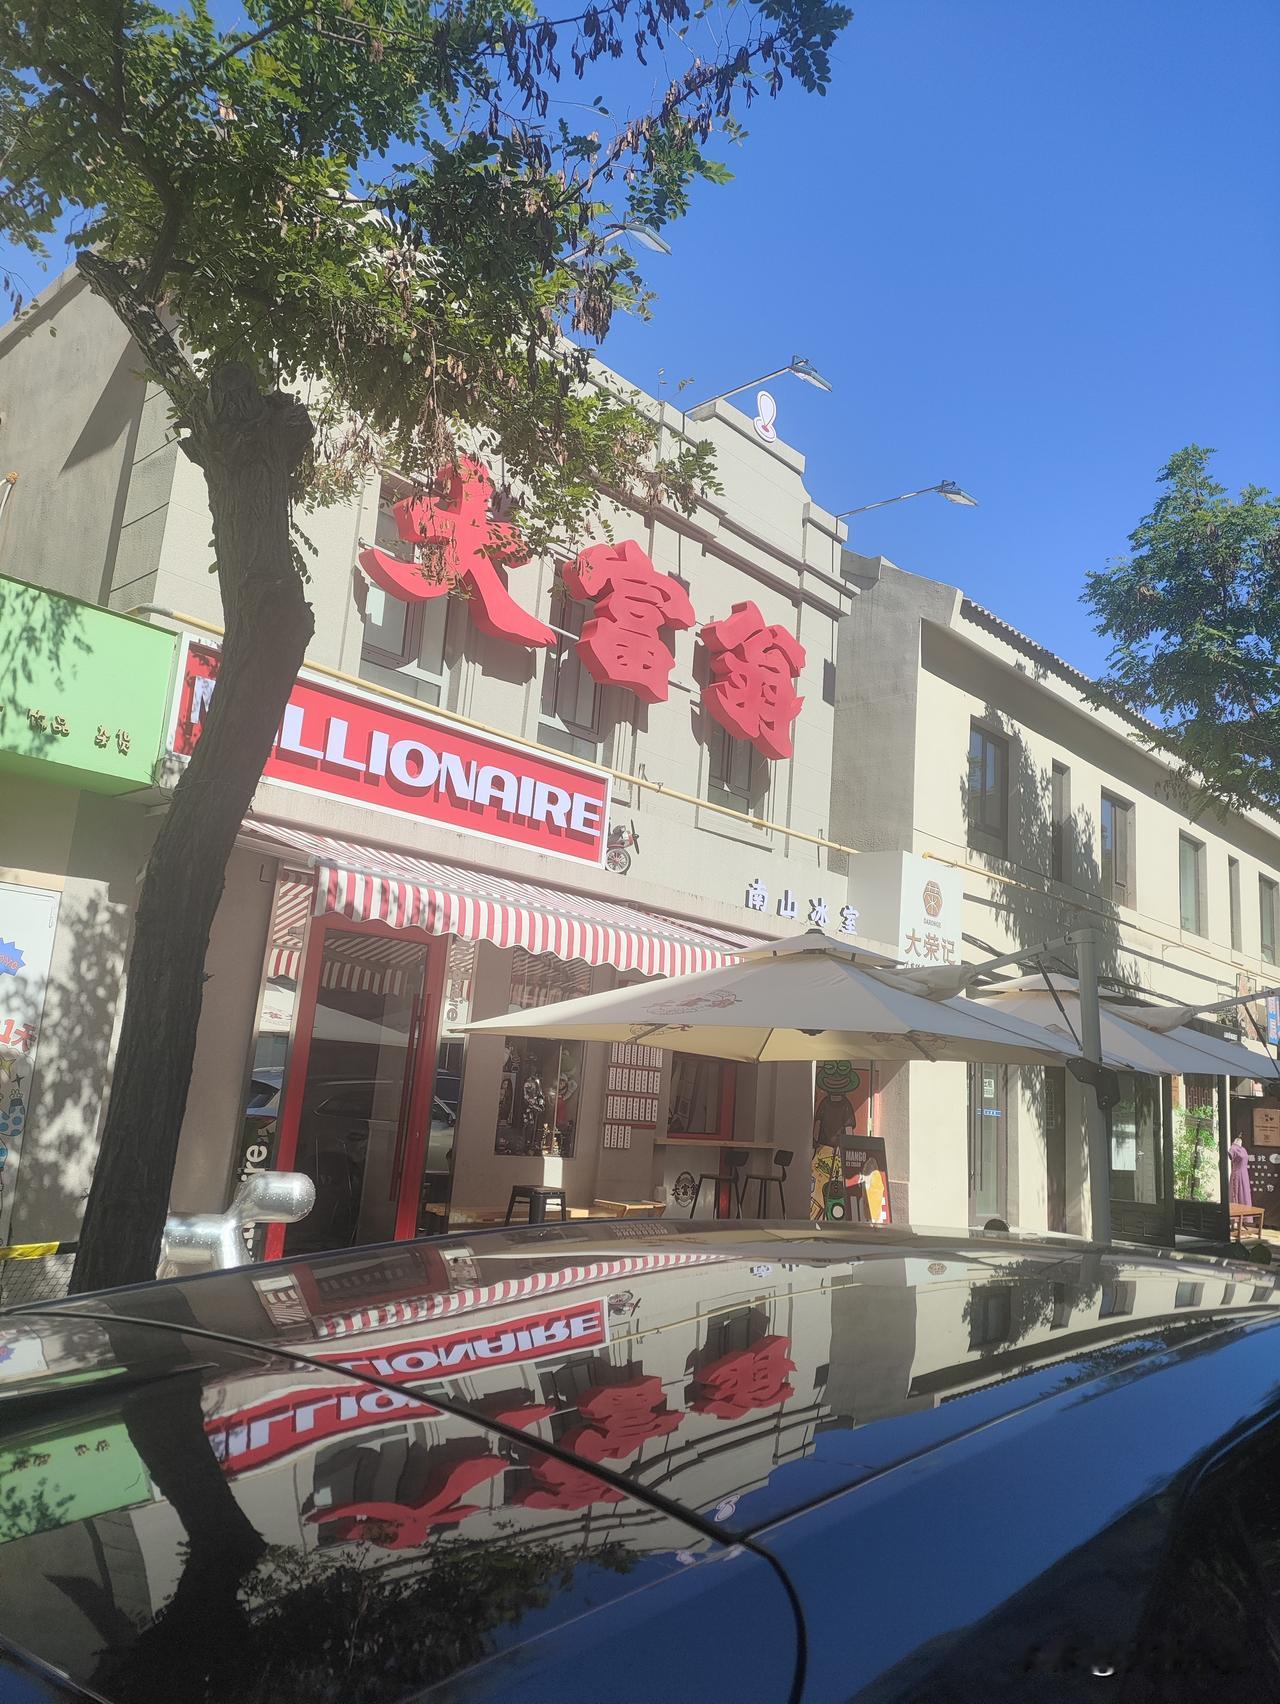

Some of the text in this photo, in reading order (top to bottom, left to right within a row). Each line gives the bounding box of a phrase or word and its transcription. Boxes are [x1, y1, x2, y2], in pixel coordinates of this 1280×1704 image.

[359, 455, 806, 760] 大富翁
[191, 676, 604, 838] LLIONAIRE
[745, 879, 859, 935] 南山冰室
[905, 928, 955, 966] 大荣记
[845, 1150, 867, 1162] MANGO
